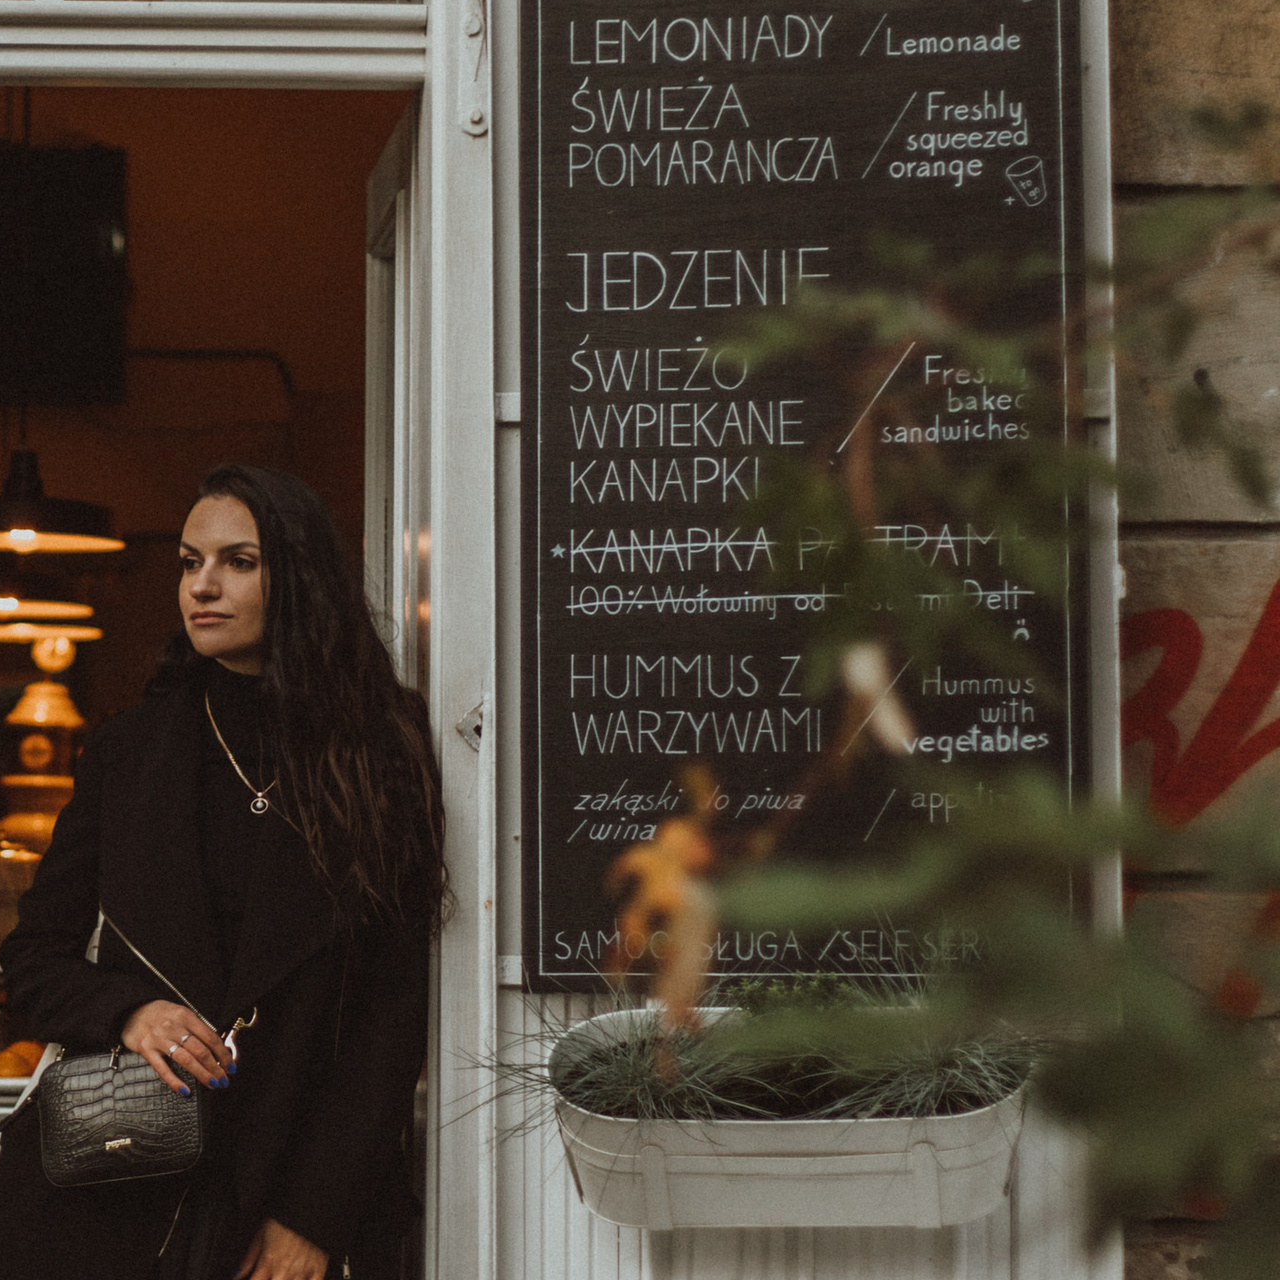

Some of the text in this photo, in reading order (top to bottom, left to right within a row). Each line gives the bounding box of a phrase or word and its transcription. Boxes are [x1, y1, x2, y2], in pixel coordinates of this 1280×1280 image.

[569, 13, 834, 66] LEMONIADY
[570, 75, 750, 134] ŚWIEŻA
[926, 90, 1023, 125] Freshly
[906, 119, 1029, 152] squeezed
[888, 157, 984, 187] orange
[565, 245, 830, 314] JEDZENIE
[569, 333, 749, 393] ŚWIEŻO
[922, 354, 1028, 388] Fres
[569, 399, 805, 451] WYPIEKANE
[879, 412, 1031, 444] sandwiches
[569, 456, 760, 505] KANAPKI
[570, 525, 776, 574] KANAPKA
[793, 583, 826, 612] od
[569, 653, 802, 700] HUMMUS Z
[922, 666, 1035, 696] Hummus
[980, 699, 1034, 723] with
[571, 707, 821, 756] WARZYWAMI
[903, 726, 1050, 763] vegetables
[573, 779, 683, 815] zakąski
[735, 786, 805, 819] piwa
[554, 930, 803, 963] SAMOOSŁUGA
